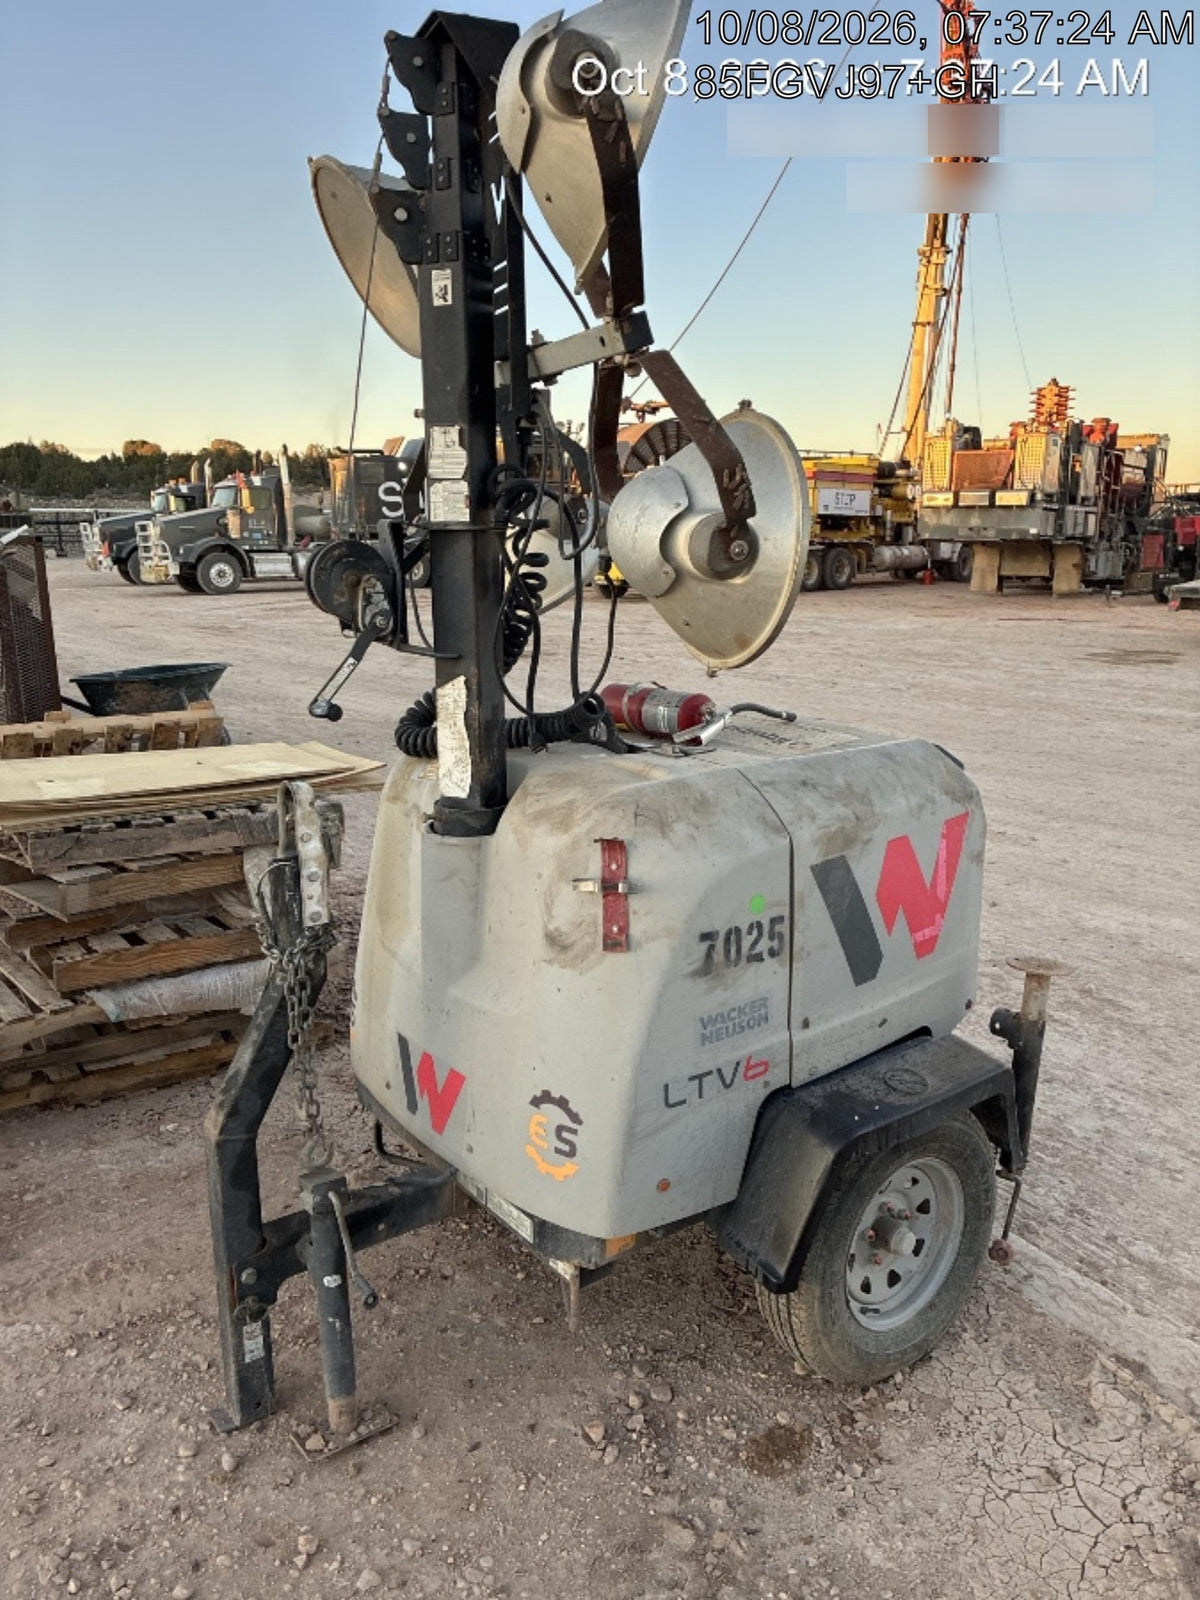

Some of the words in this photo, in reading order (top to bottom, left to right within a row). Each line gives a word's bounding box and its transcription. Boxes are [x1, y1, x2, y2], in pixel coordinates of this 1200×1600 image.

[698, 915, 785, 978] 7025
[700, 996, 769, 1031] WACKER
[700, 1011, 769, 1047] NEUSON
[663, 1055, 770, 1109] LTV6
